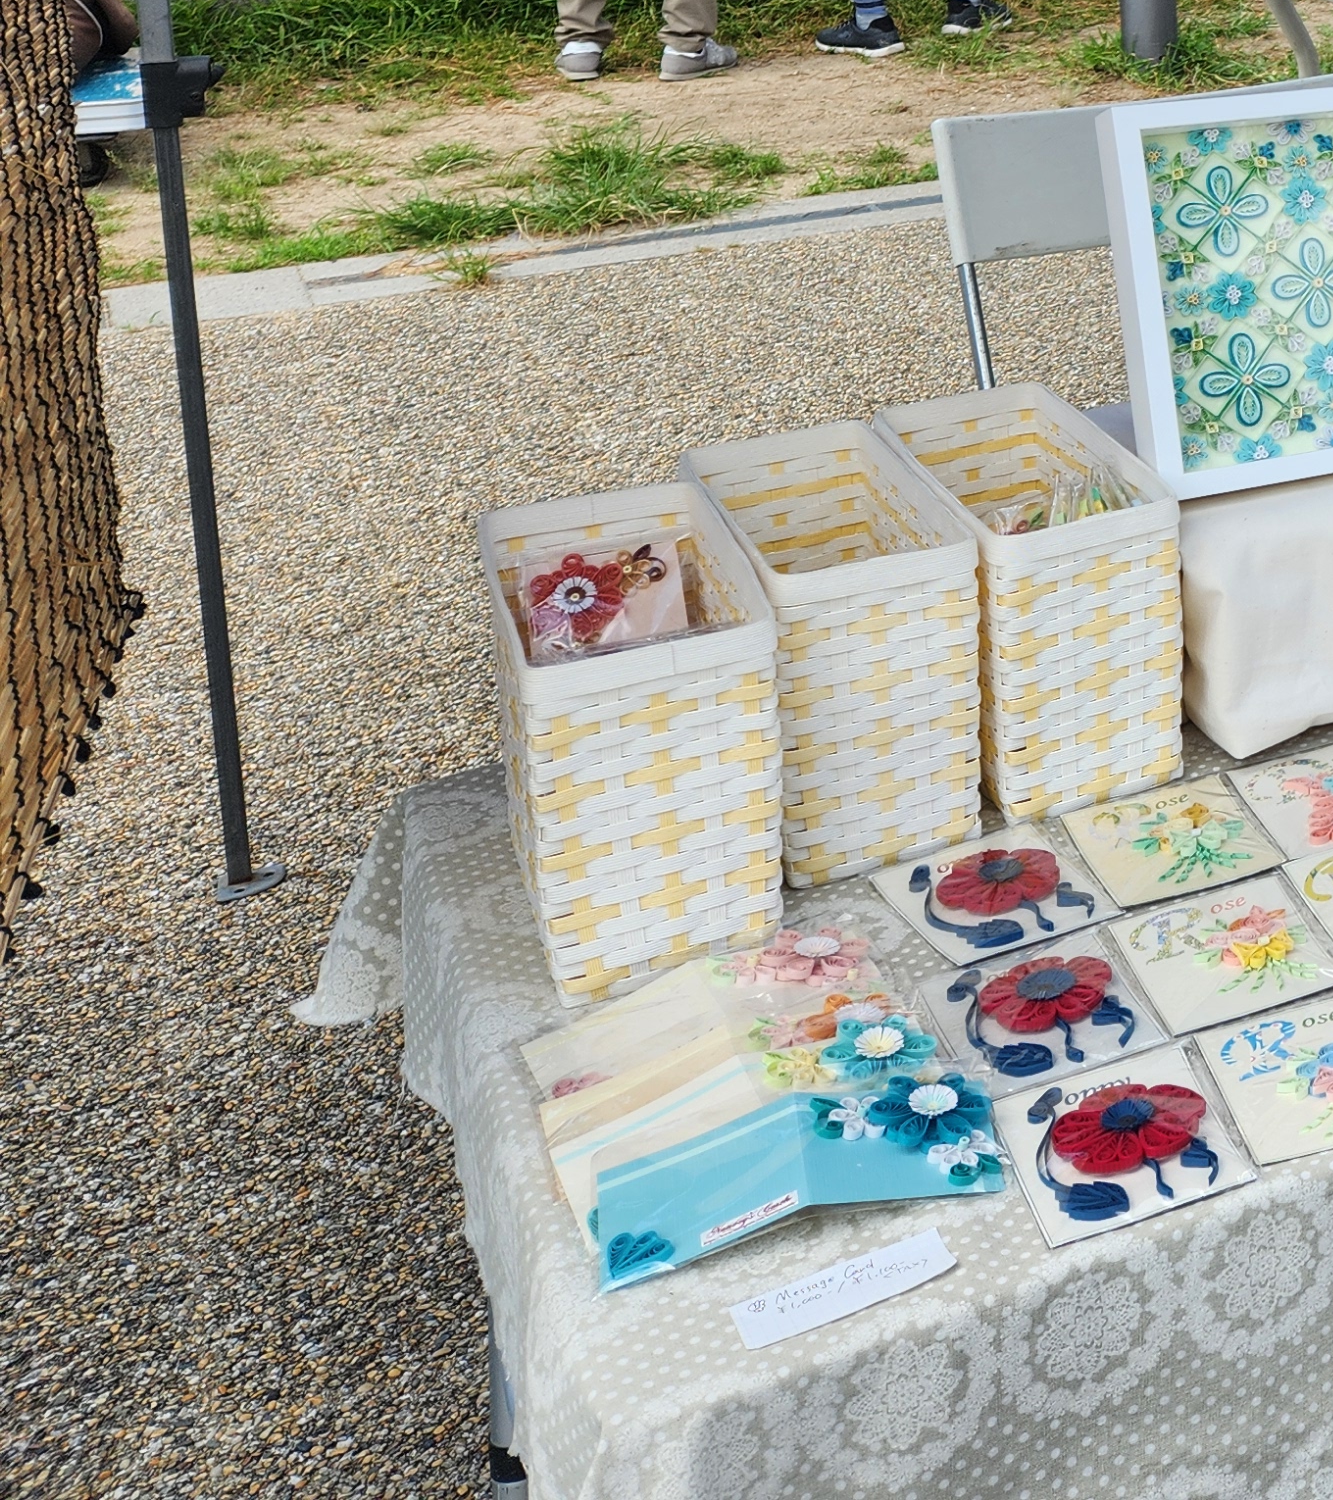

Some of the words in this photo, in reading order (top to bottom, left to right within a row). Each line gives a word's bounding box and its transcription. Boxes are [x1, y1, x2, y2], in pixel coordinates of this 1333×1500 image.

[1155, 792, 1190, 810] ose
[1210, 895, 1247, 915] ose
[775, 1276, 834, 1305] Message
